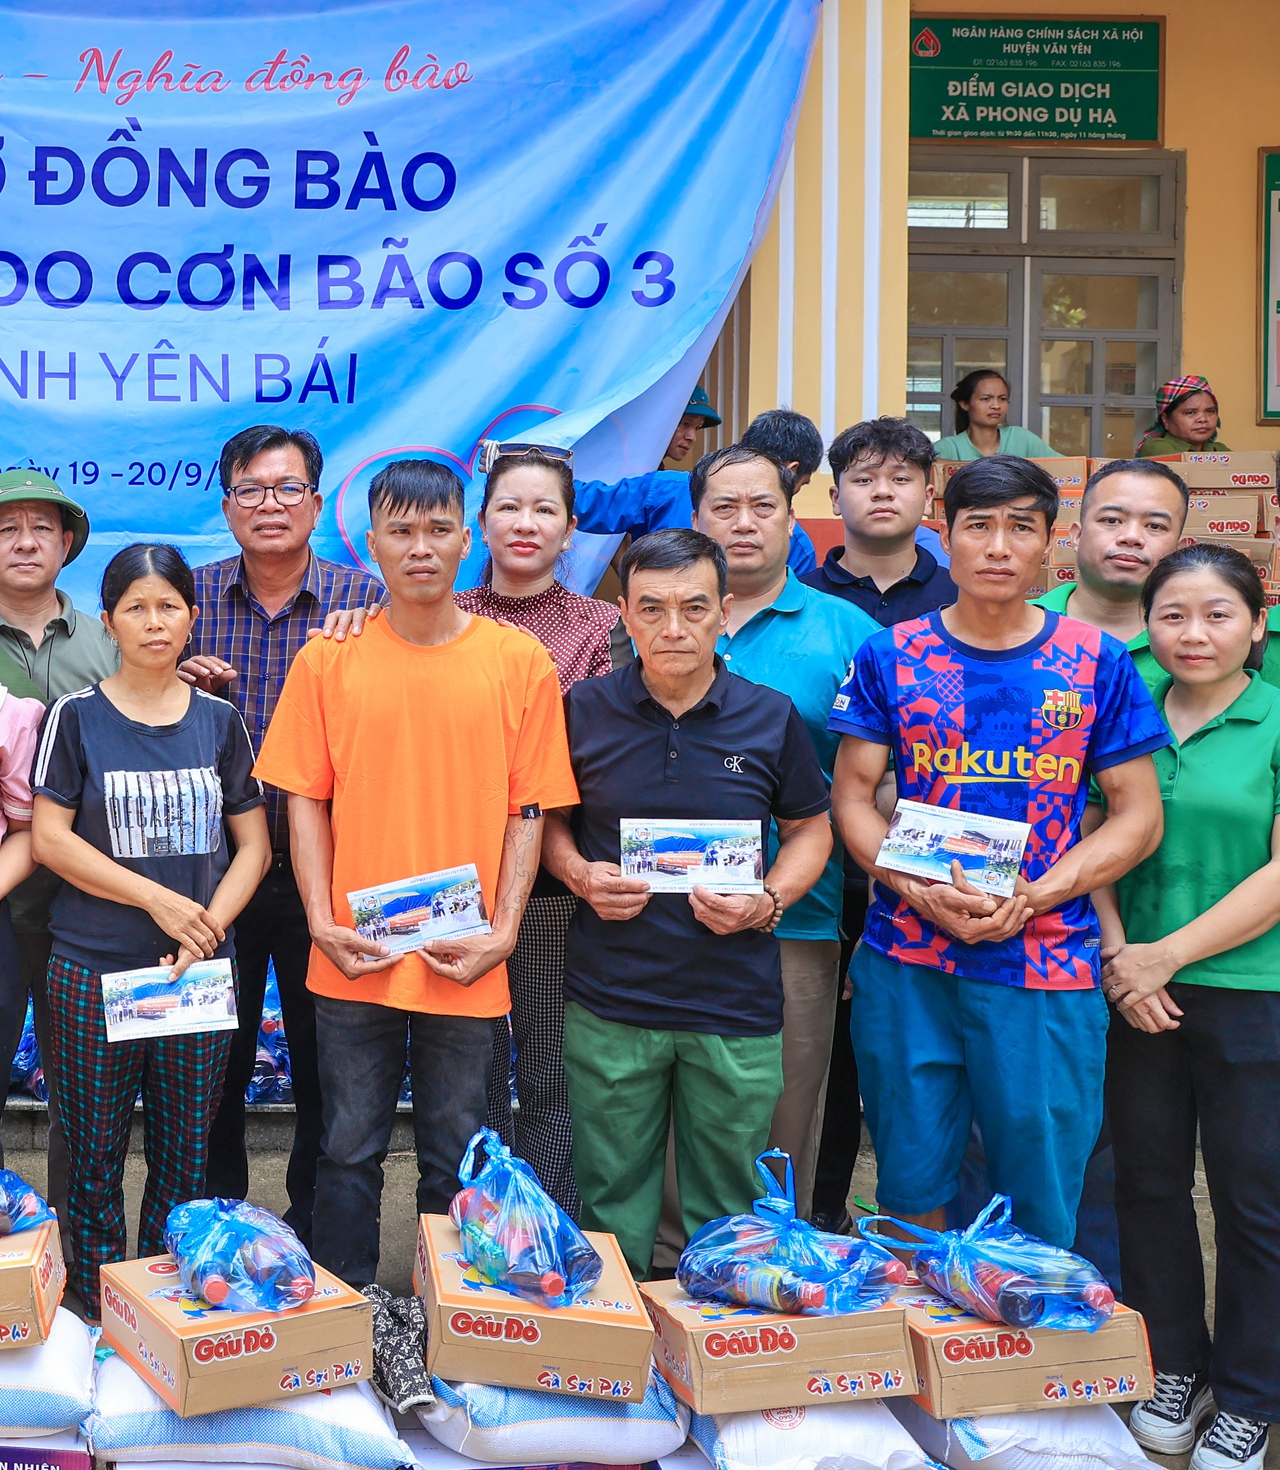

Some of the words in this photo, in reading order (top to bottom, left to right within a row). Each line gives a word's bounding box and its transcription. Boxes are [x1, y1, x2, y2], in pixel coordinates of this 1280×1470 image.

[952, 26, 986, 38] NGÂN
[990, 26, 1023, 38] HÀNG
[1027, 27, 1063, 39] CHÍNH
[1067, 27, 1099, 39] SÁCH
[1102, 28, 1118, 40] XÃ
[1123, 28, 1143, 42] HỘI
[1003, 42, 1039, 56] HUYỆN
[1043, 42, 1067, 54] VĂN
[1071, 43, 1091, 54] YÊN
[73, 46, 231, 105] Nghĩa
[245, 48, 370, 106] đồng
[384, 43, 474, 90] bào
[947, 73, 995, 97] ĐIỂM
[1001, 81, 1054, 99] GIAO
[1060, 82, 1111, 102] DỊCH
[941, 102, 970, 122] XÃ
[976, 106, 1049, 123] PHONG
[1055, 107, 1082, 127] DỤ
[1088, 108, 1117, 128] HẠ
[28, 117, 270, 209] ĐỒNG
[293, 131, 456, 211] BÀO
[120, 243, 293, 312] CƠN
[317, 238, 484, 311] BÃO
[502, 223, 612, 311] SỐ
[631, 251, 677, 308] 3
[99, 339, 231, 403] YÊN
[254, 336, 358, 405] BÁI
[69, 461, 100, 484] 19
[912, 741, 1081, 784] Rakuten
[279, 1372, 302, 1391] Gà
[536, 1371, 562, 1390] Gà
[807, 1376, 832, 1396] Gà
[1043, 1381, 1069, 1400] Gà
